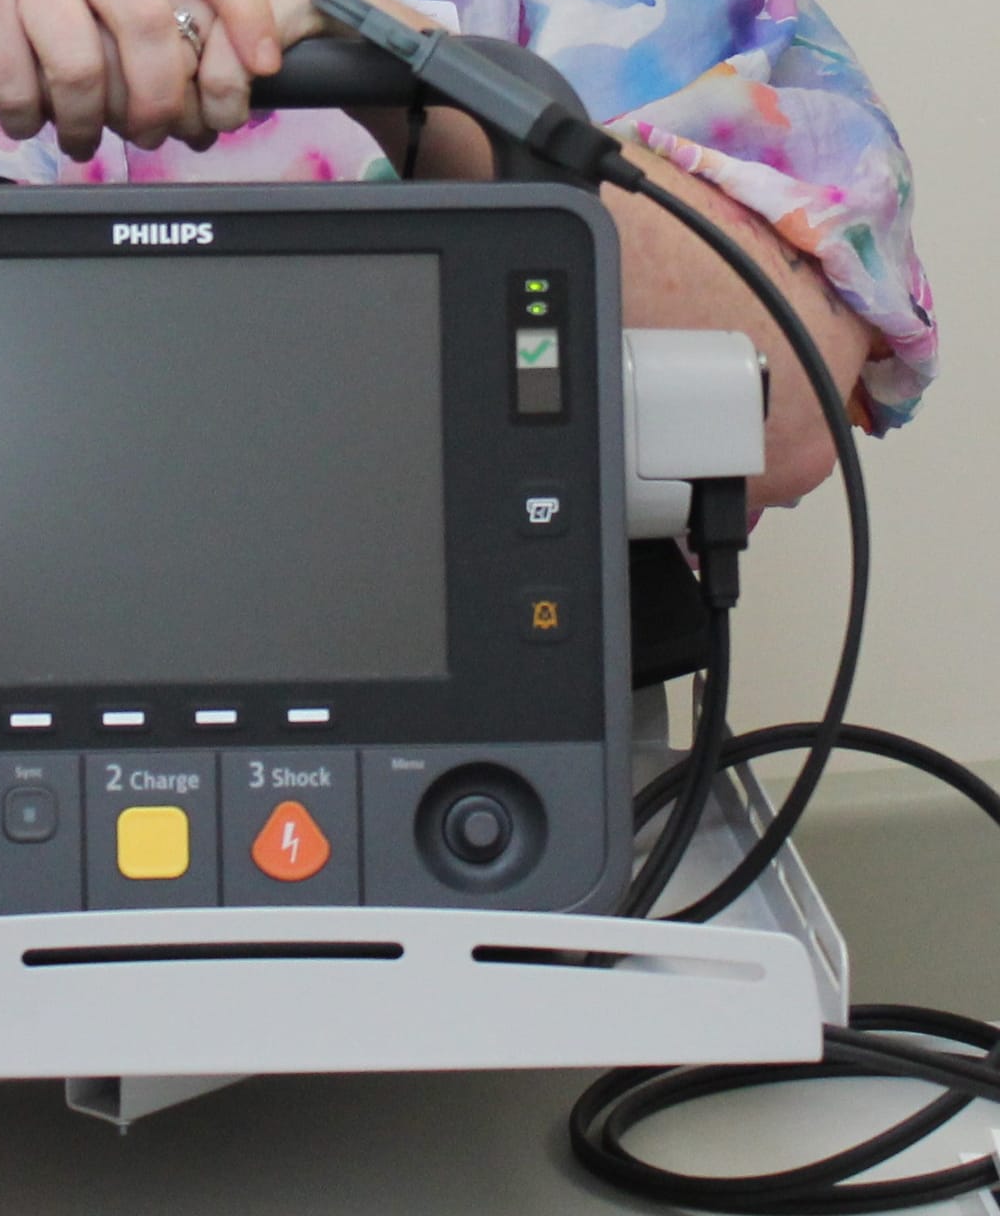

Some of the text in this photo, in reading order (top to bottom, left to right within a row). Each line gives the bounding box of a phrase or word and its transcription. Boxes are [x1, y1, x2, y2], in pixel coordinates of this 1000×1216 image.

[112, 222, 214, 245] PHILIPS
[105, 764, 200, 793] 2 Charge
[249, 762, 332, 790] 3 Shock
